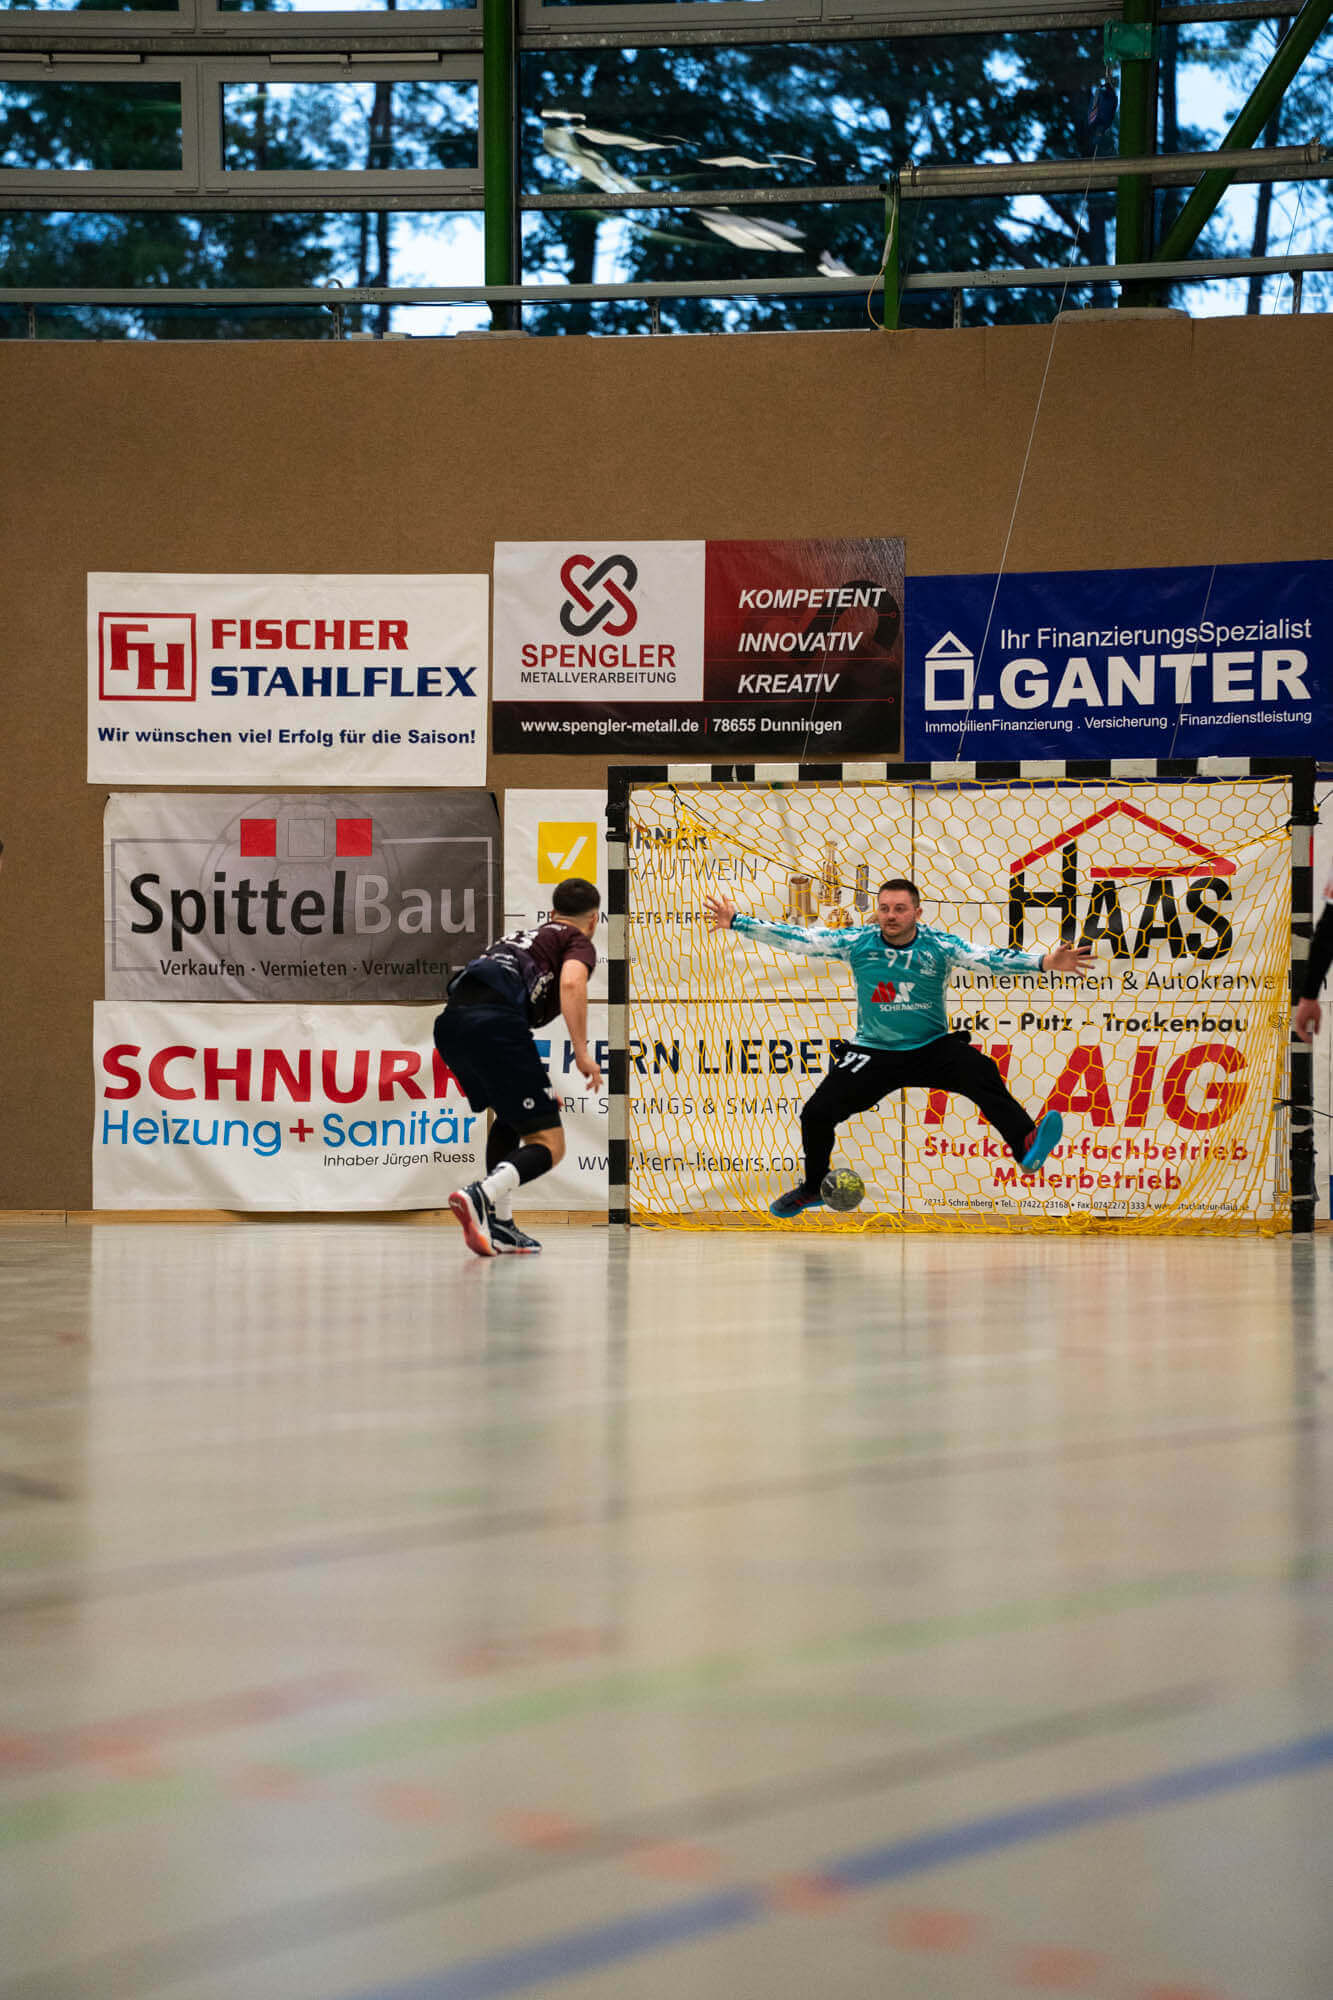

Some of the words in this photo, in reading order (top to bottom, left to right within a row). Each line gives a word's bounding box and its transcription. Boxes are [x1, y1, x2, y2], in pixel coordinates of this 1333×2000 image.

[738, 587, 886, 609] KOMPETENT
[210, 618, 409, 651] FISCHER
[738, 631, 863, 653] INNOVATIV
[1000, 628, 1031, 650] Ihr
[1037, 618, 1312, 651] FinanzierungsSpezialist
[521, 643, 676, 668] SPENGLER
[210, 666, 478, 698] STAHLFLEX
[520, 671, 676, 684] METALLVERARBEITUNG
[737, 673, 840, 694] KREATIV
[521, 718, 699, 736] www.spengler-metall.de
[713, 718, 756, 733] 78655
[761, 717, 842, 736] Dunningen
[925, 718, 1073, 734] ImmobilienFinanzierung
[1084, 715, 1168, 730] Versicherung
[1180, 710, 1312, 727] Finanzdienstleistung
[98, 727, 130, 743] Wir
[135, 728, 231, 744] wünschen
[238, 729, 271, 744] viel
[279, 729, 333, 747] Erfolg
[339, 729, 366, 745] für
[372, 729, 401, 745] die
[408, 729, 476, 745] Saison!
[627, 858, 757, 880] RAUTWEIN
[130, 871, 475, 952] SpittelBau
[1009, 842, 1234, 960] HAAS
[160, 959, 245, 977] Verkaufen
[260, 960, 347, 977] Vermieten
[361, 960, 449, 976] Verwalten
[884, 948, 913, 969] 97
[1122, 970, 1138, 990] &
[1020, 1012, 1073, 1032] Putz
[1102, 1012, 1248, 1033] Trockenbau
[838, 1051, 871, 1074] 97
[702, 1097, 715, 1115] &
[102, 1109, 281, 1157] Heizung
[322, 1108, 476, 1148] Sanitär
[323, 1154, 379, 1167] Inhaber
[382, 1152, 429, 1170] Jürgen
[433, 1151, 476, 1164] Ruess
[993, 1166, 1182, 1191] Malerbetrieb
[948, 1198, 993, 1209] Schramberg
